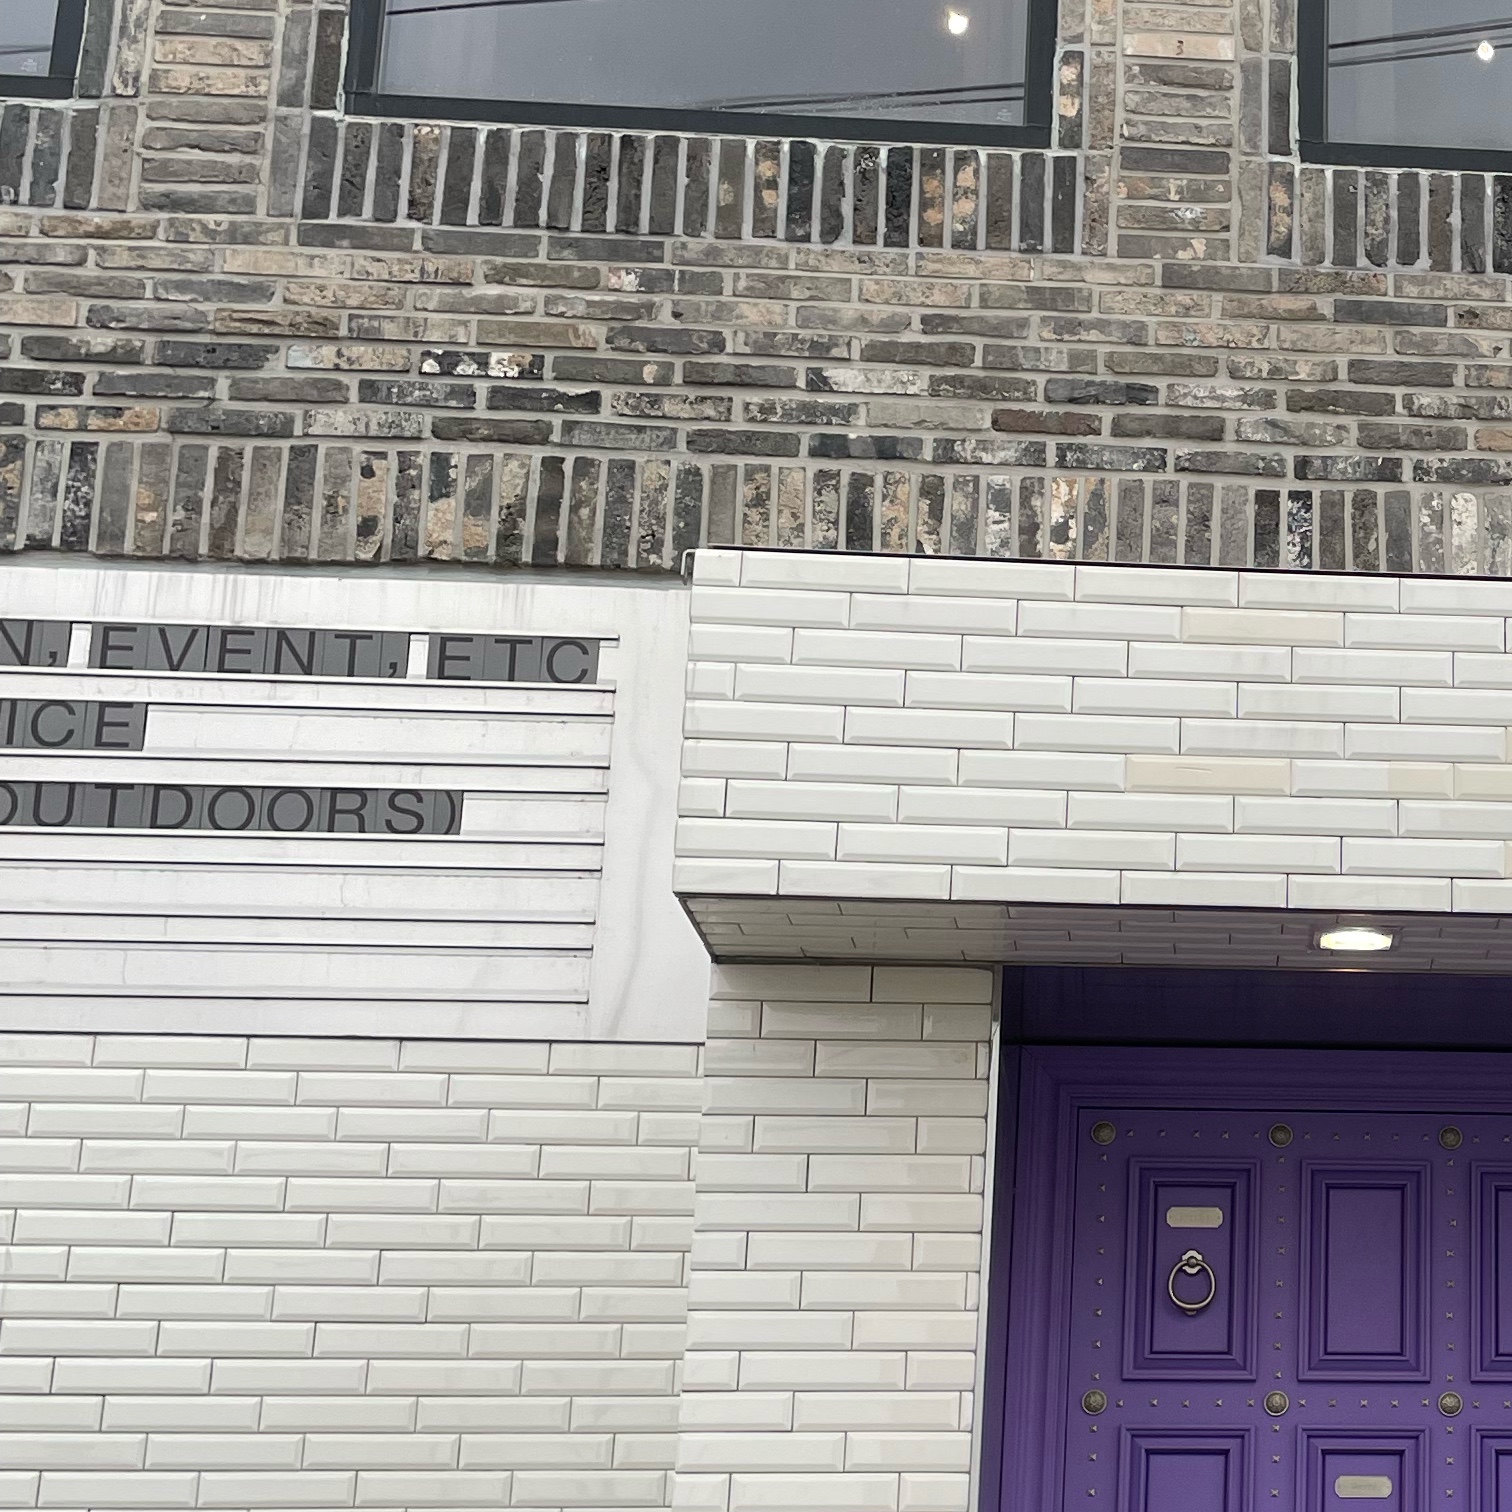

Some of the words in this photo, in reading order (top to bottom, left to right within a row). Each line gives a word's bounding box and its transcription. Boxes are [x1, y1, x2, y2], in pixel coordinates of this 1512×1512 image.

[99, 625, 400, 679] EVENT,
[436, 636, 590, 684] ETC
[6, 700, 134, 748] ICE
